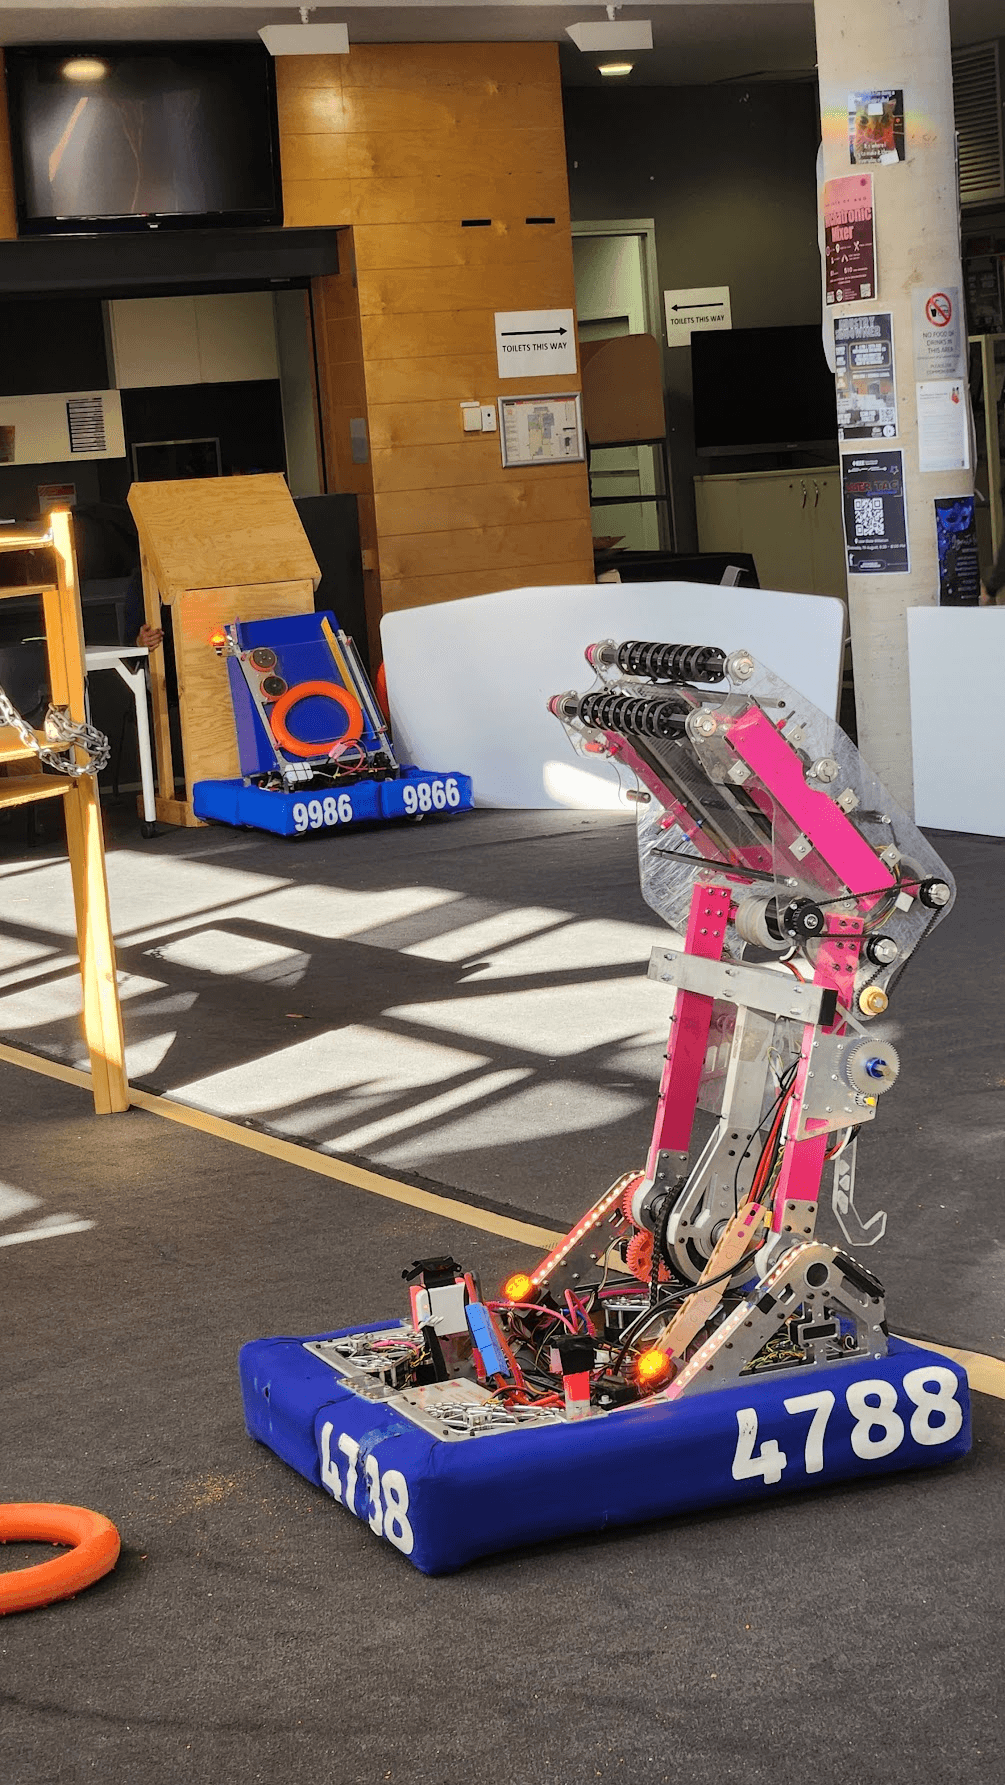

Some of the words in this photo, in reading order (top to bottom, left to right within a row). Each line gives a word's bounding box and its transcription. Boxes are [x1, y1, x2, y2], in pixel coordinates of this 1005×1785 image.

[825, 207, 872, 228] atronic
[831, 225, 854, 242] Mixer
[671, 317, 694, 325] TOILETS
[696, 315, 709, 323] THIS
[710, 314, 724, 322] WAY
[502, 343, 530, 352] TOILETS
[532, 341, 548, 351] THIS
[549, 341, 567, 350] WAY
[403, 778, 460, 814] 9866
[293, 794, 352, 831] 9986
[732, 1366, 962, 1484] 4788
